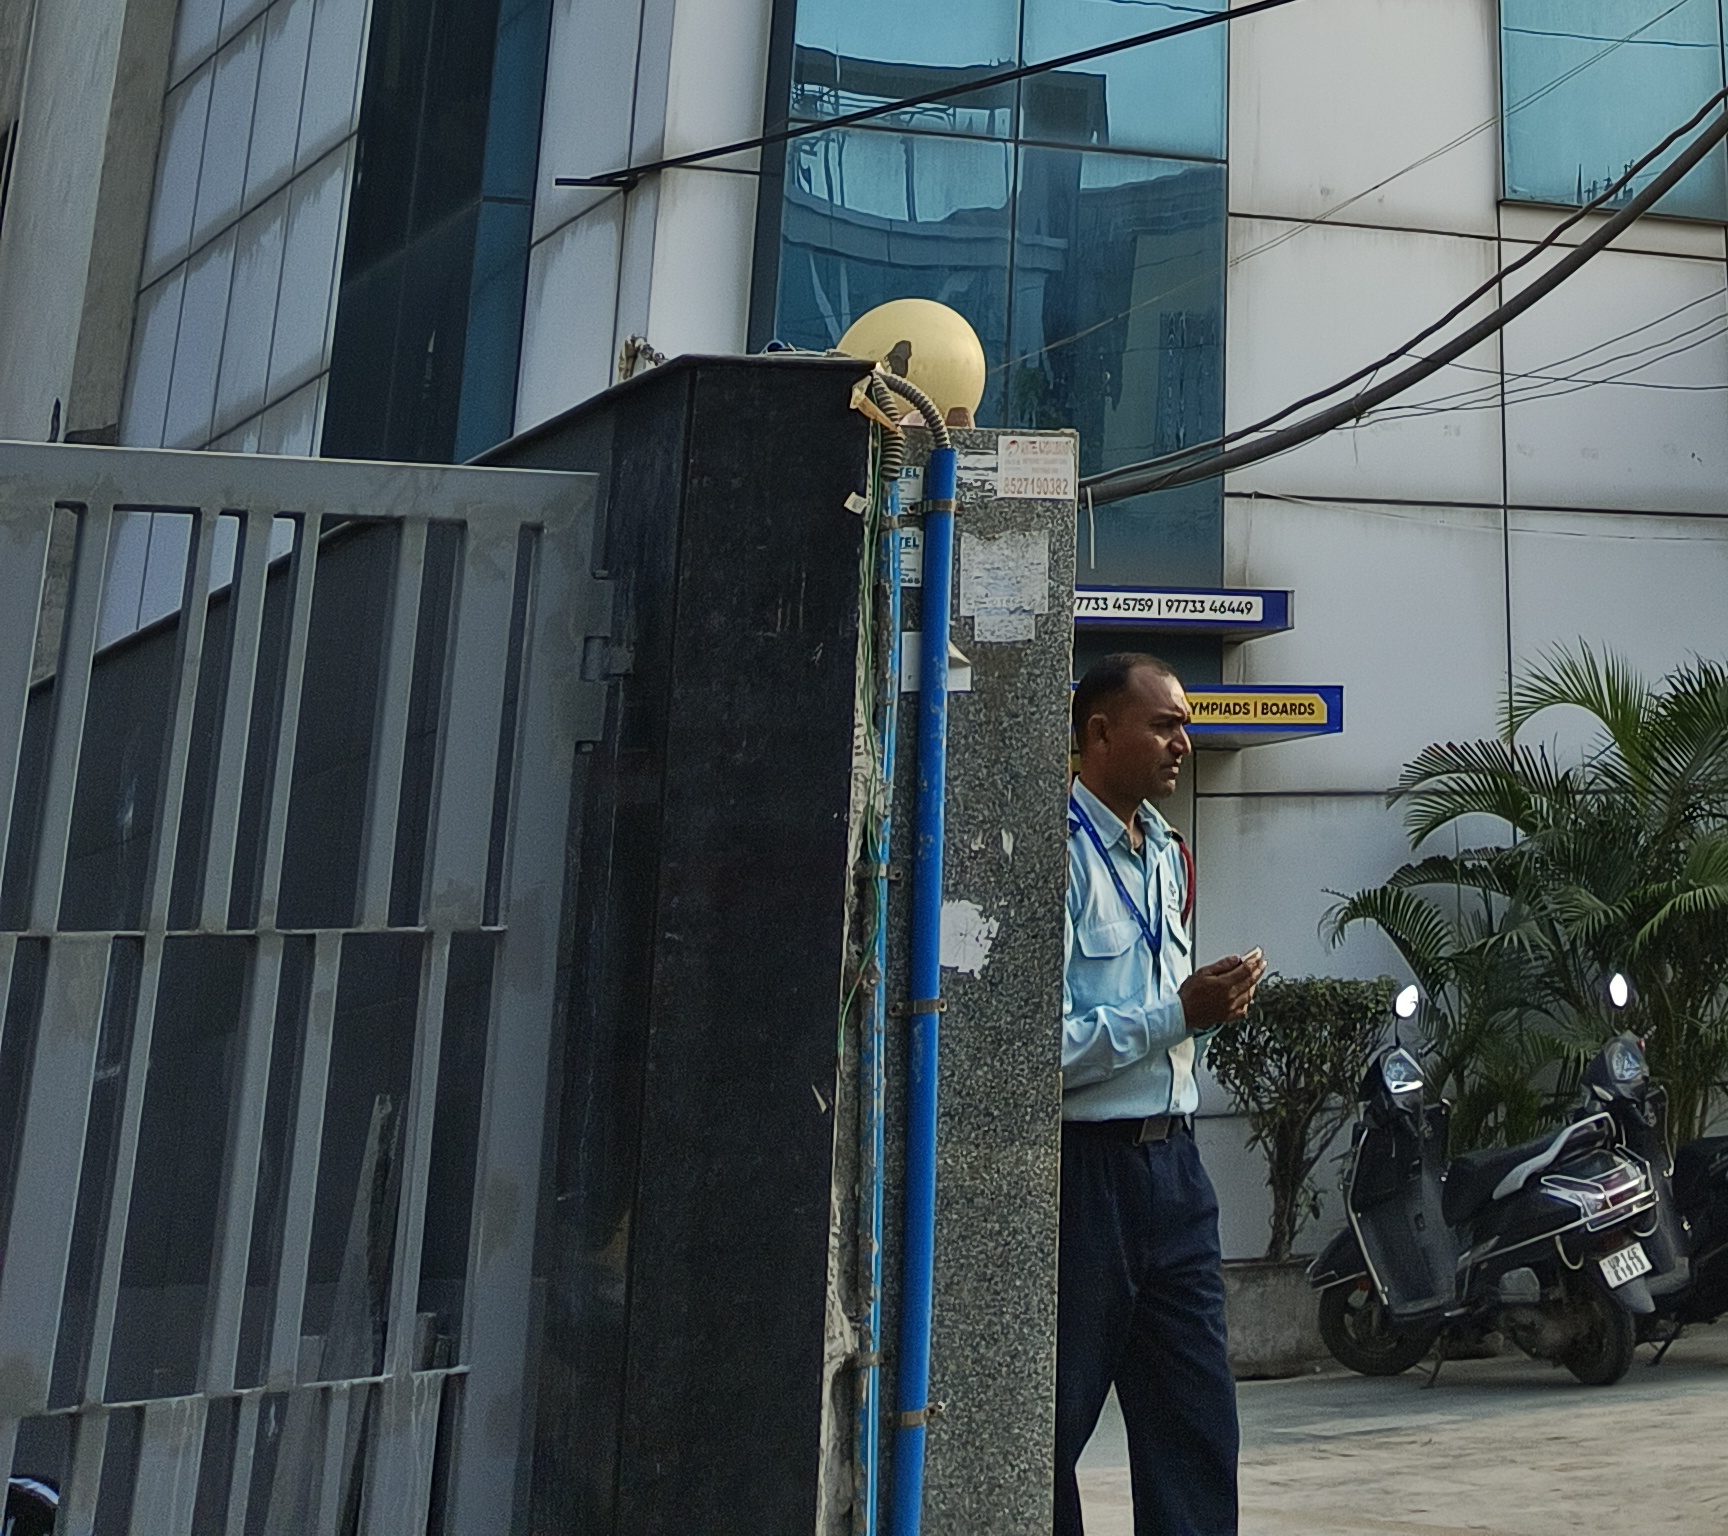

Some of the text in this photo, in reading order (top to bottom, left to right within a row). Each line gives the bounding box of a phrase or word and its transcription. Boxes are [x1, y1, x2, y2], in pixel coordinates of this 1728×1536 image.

[1075, 596, 1253, 615] 7733 45759 97733 46449
[1189, 701, 1315, 716] YMPIADS BOARDS
